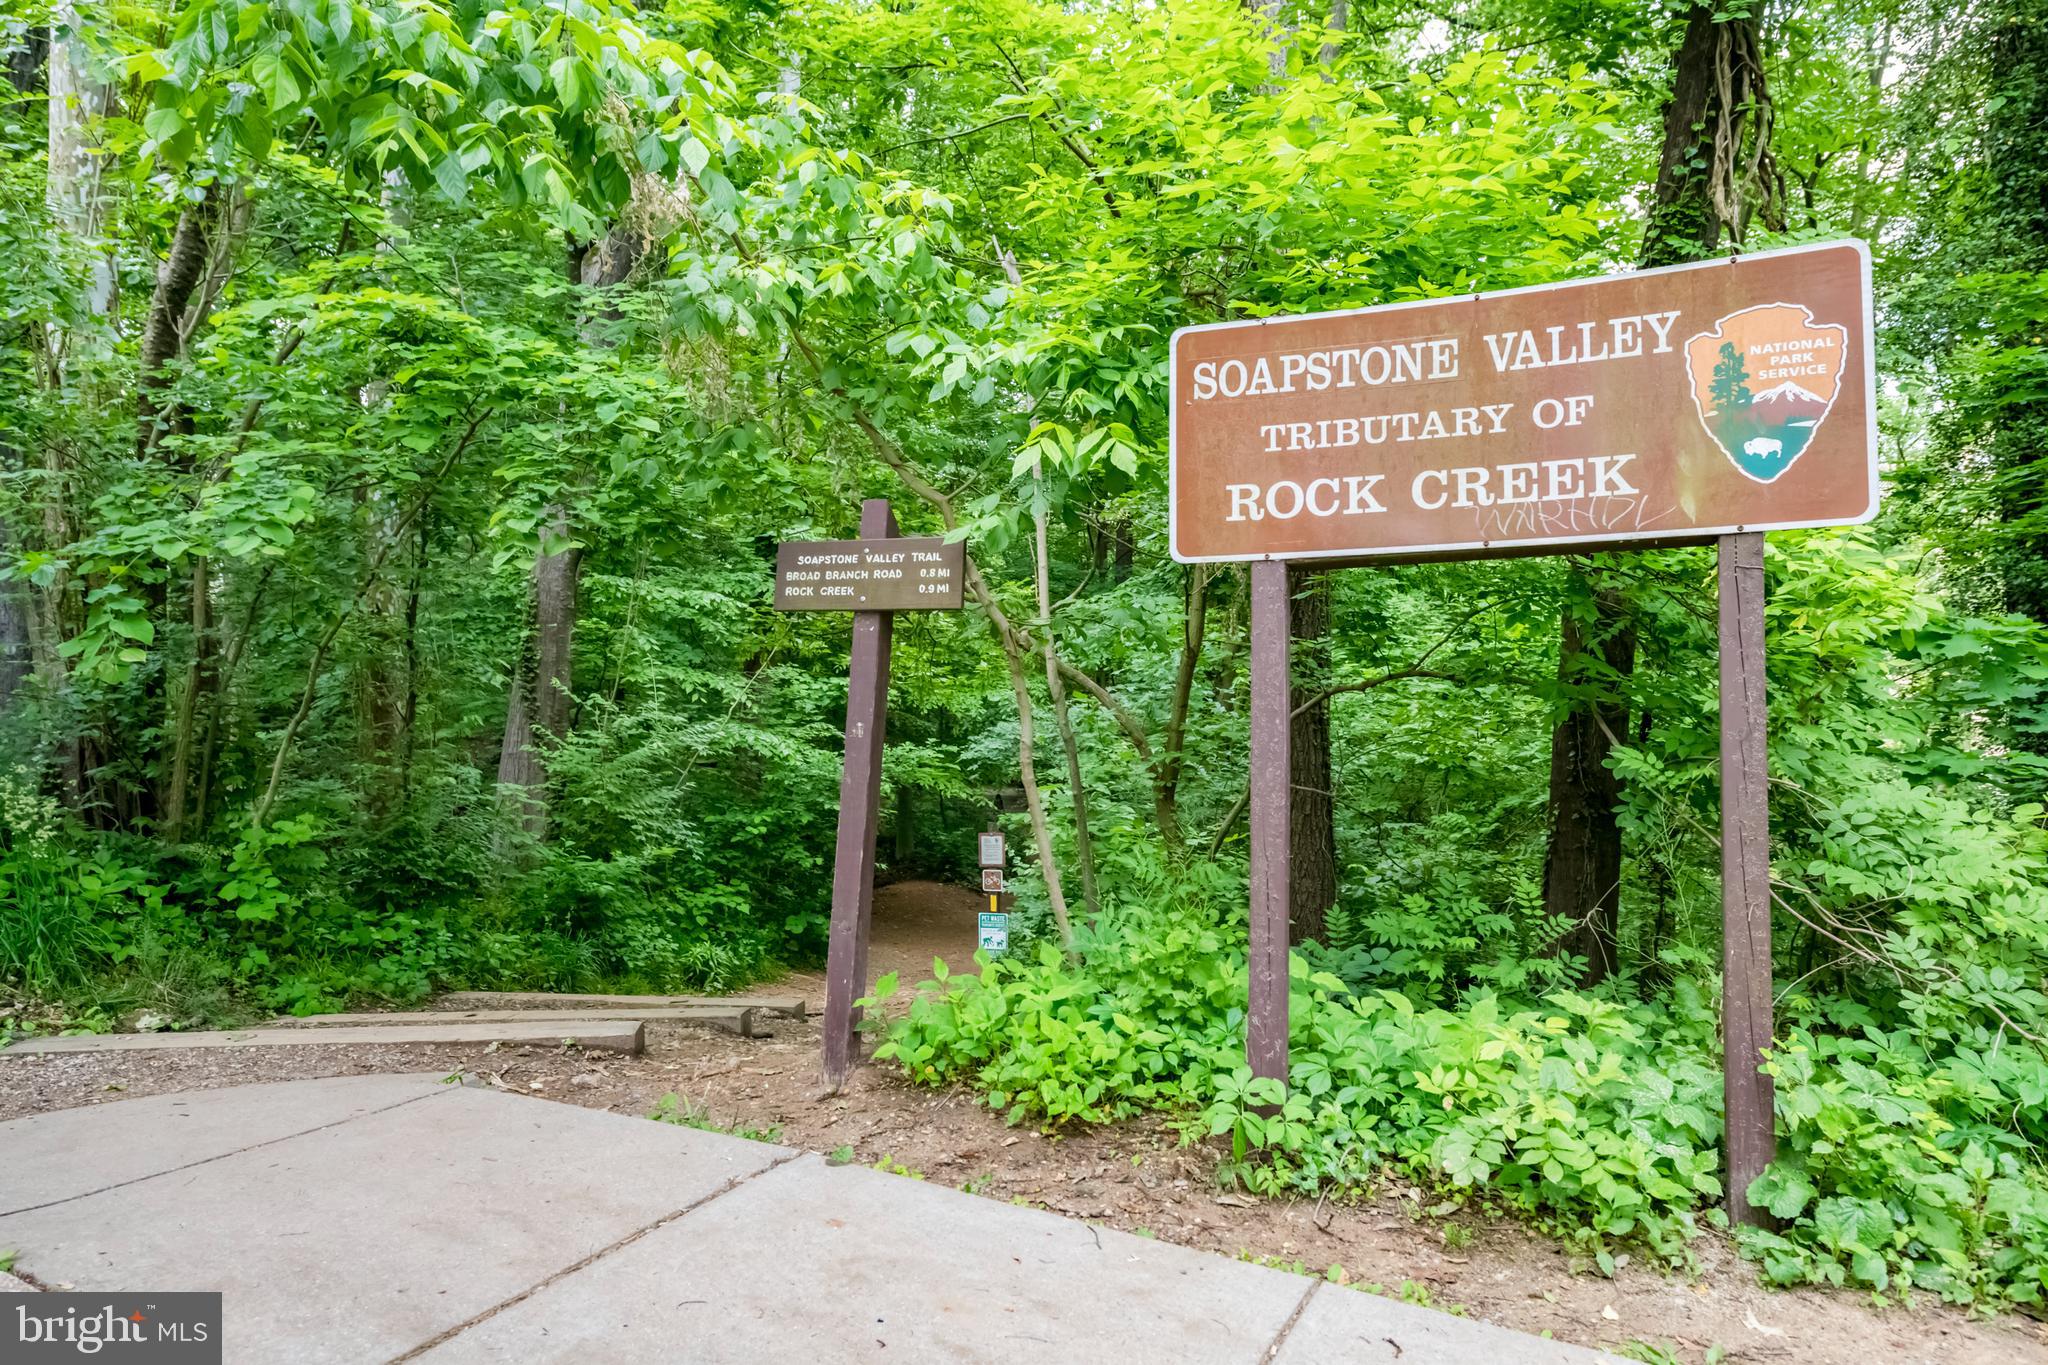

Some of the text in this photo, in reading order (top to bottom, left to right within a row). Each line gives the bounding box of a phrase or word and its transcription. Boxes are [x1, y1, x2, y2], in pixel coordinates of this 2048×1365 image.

[1750, 337, 1835, 355] NATIONAL
[1193, 310, 1681, 400] SOAPSTONE VALLEY
[1770, 352, 1814, 366] PARK
[1758, 364, 1827, 380] SERVICE
[1261, 395, 1594, 452] TRIBUTARY OF
[1225, 453, 1640, 522] ROCK CREEK
[797, 552, 942, 565] SOAPSTONE VALLEY TRAIL
[786, 568, 950, 581] BROAD BRANCH ROAD 0.8 MI
[785, 583, 949, 596] ROCK CREEK 0.9 MI
